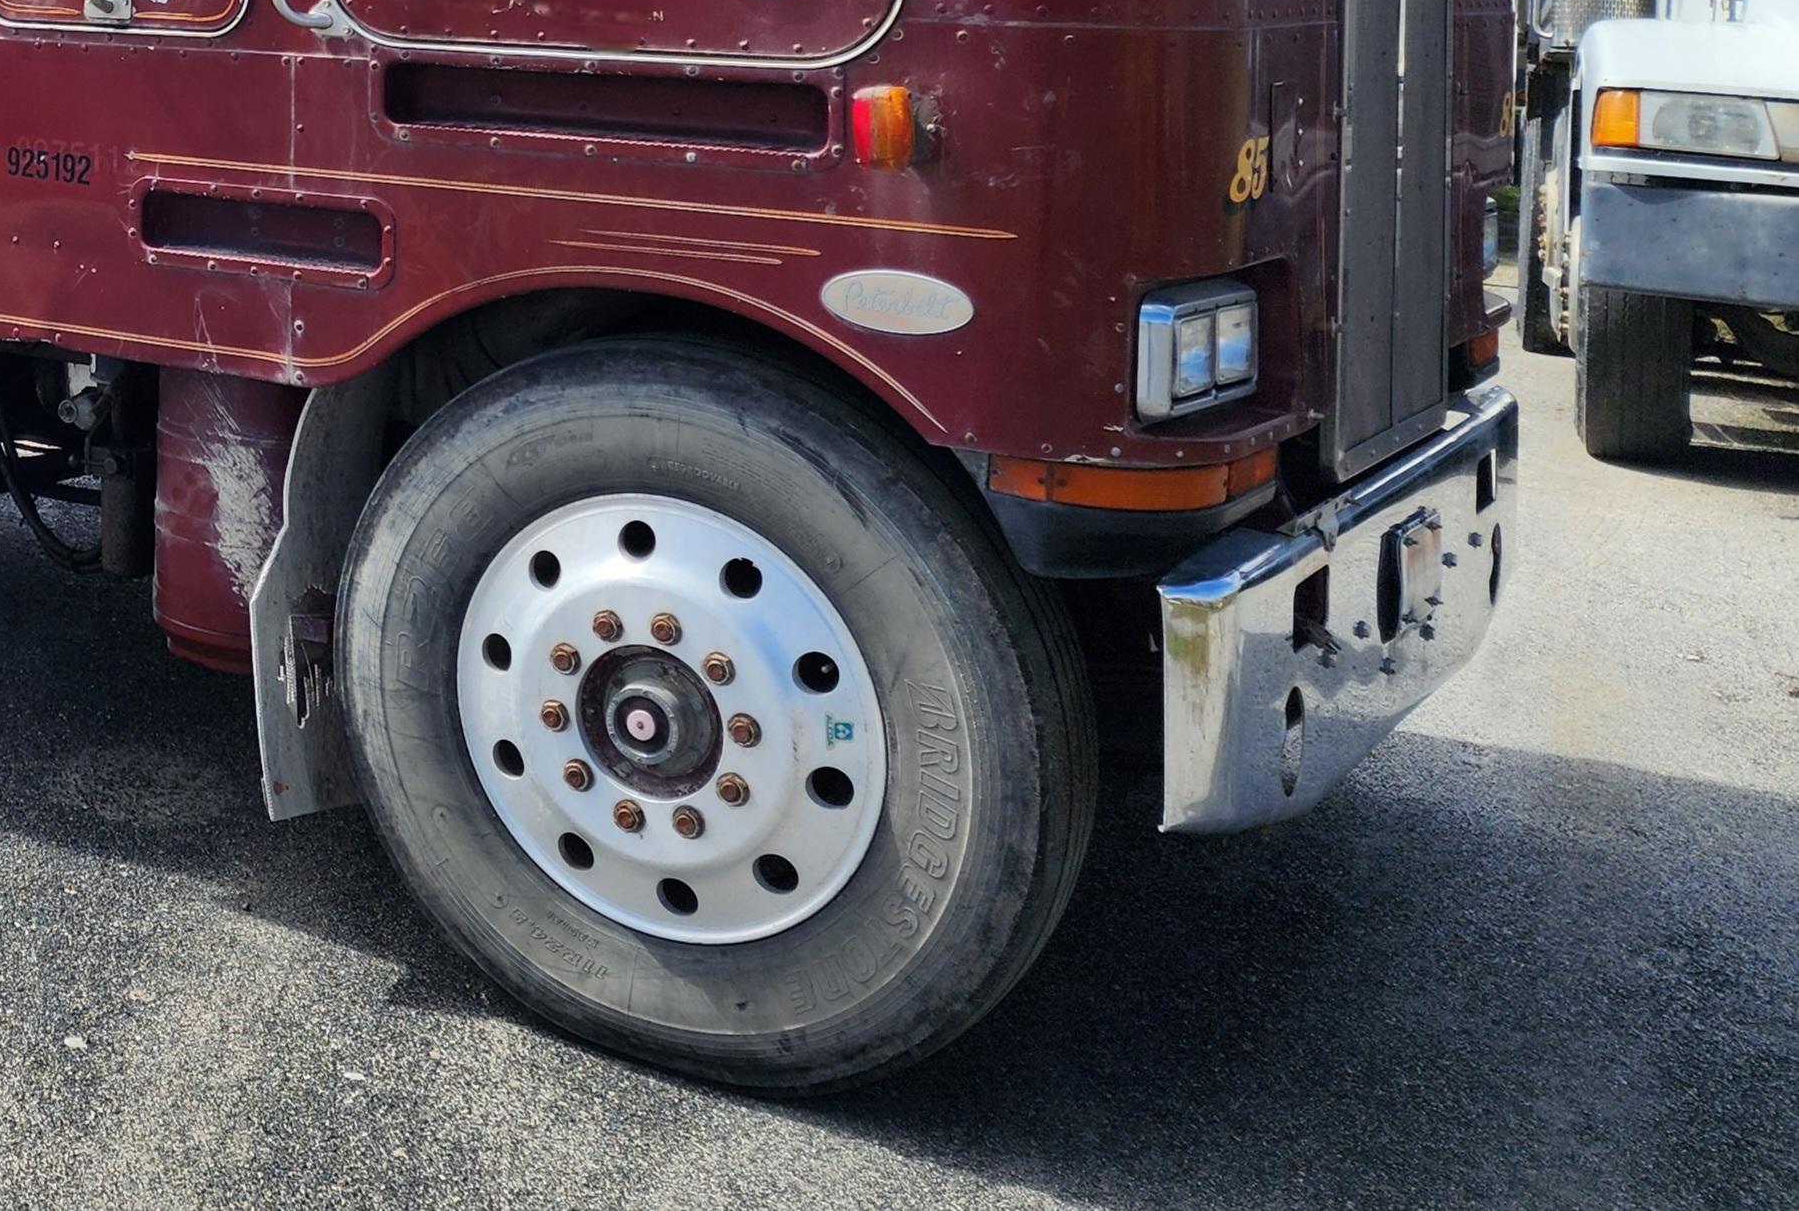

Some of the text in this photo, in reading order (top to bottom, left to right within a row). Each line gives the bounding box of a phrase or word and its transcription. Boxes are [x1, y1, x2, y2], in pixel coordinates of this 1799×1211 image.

[7, 146, 92, 186] 925192
[1229, 135, 1270, 203] 85
[842, 280, 961, 321] Peterbilt
[784, 678, 960, 1017] BRIDGESTONE
[508, 907, 609, 981] 11R24.5
